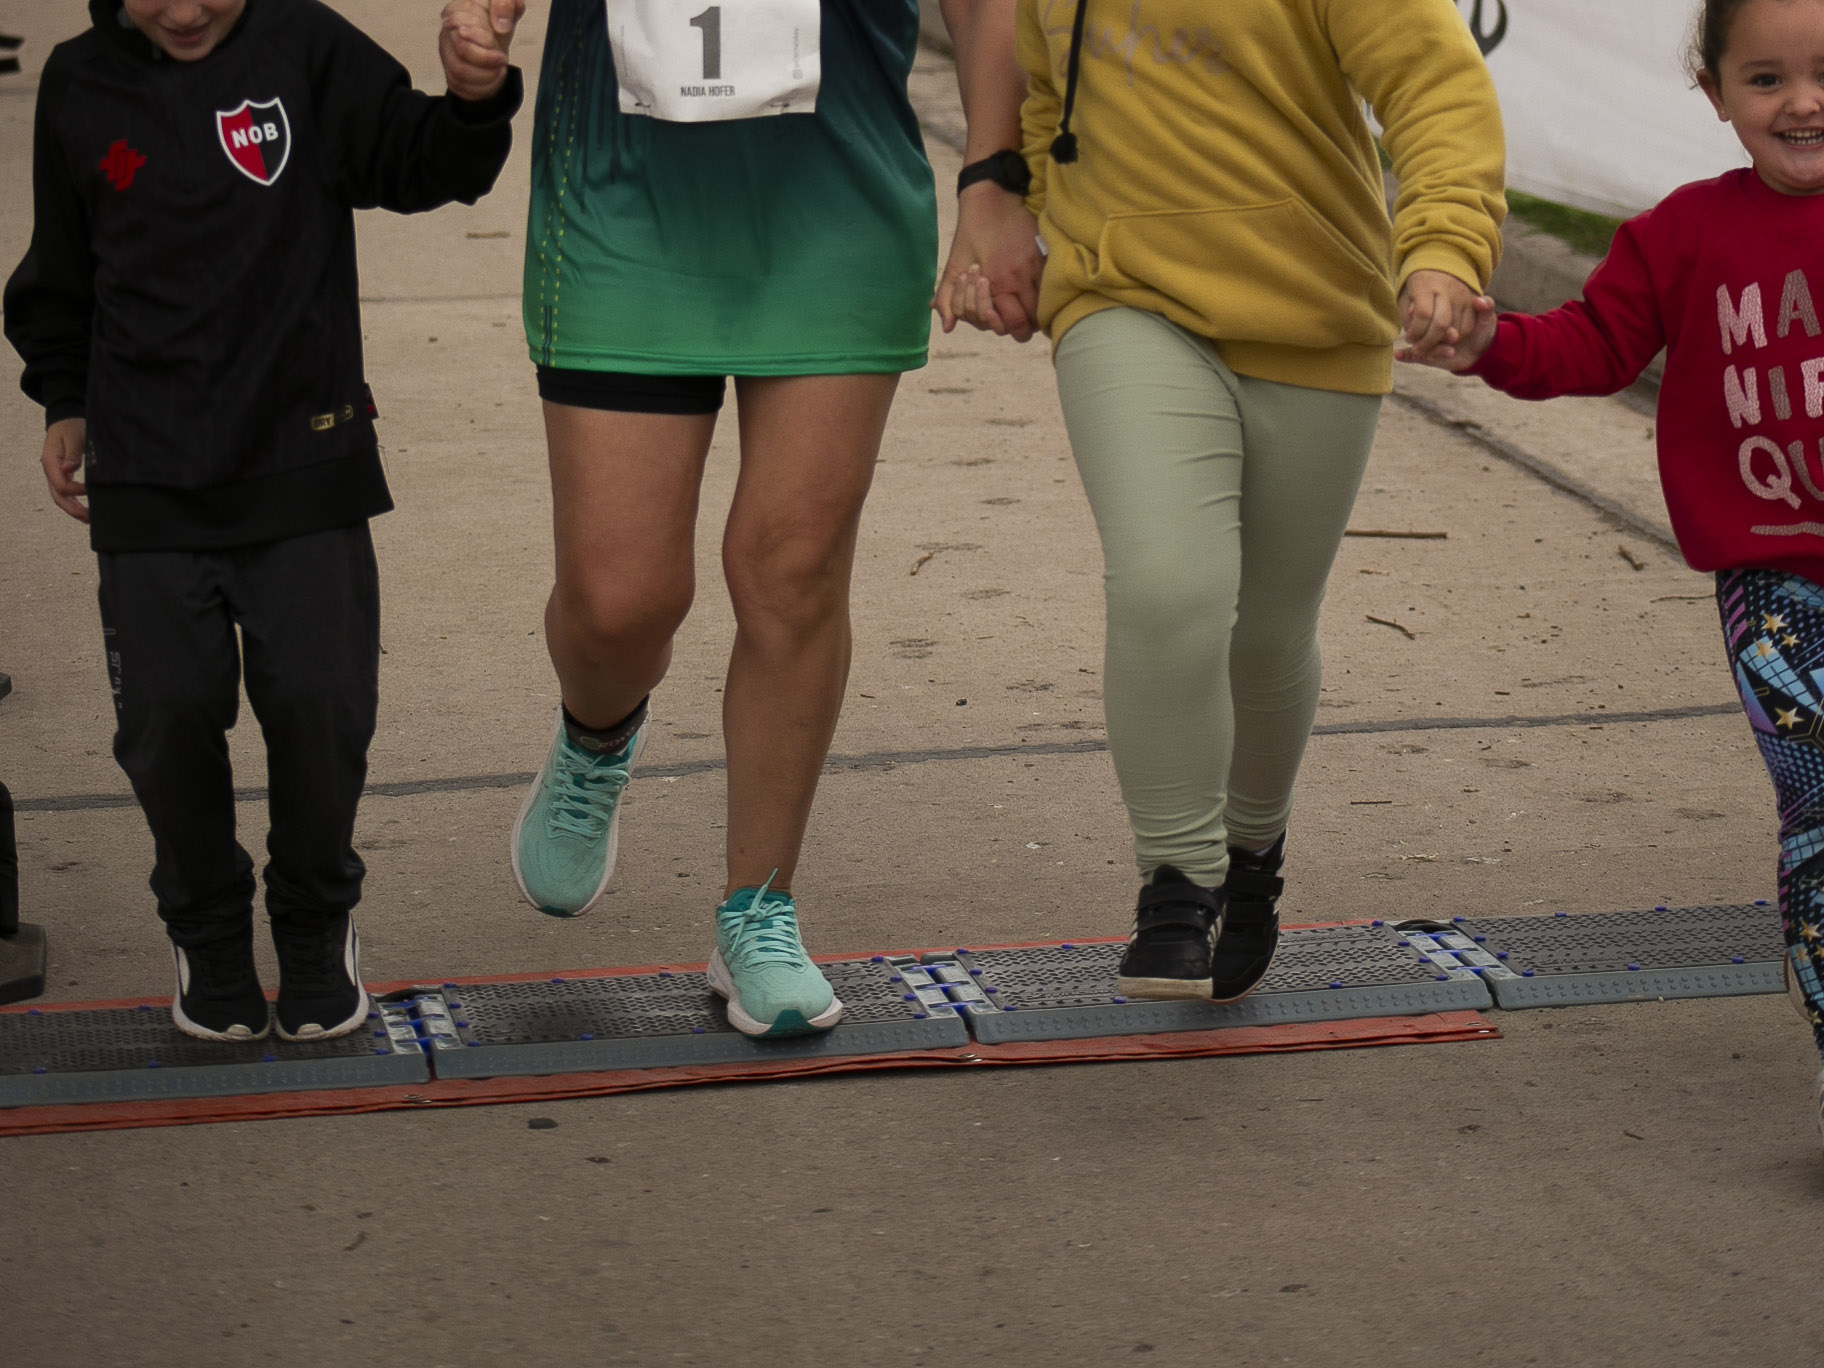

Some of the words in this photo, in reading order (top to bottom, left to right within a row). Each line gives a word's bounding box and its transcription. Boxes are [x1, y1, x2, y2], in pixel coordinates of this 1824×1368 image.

[689, 5, 721, 80] 1
[680, 85, 707, 97] NADIA
[708, 85, 736, 97] HOFER
[231, 122, 279, 149] NOB
